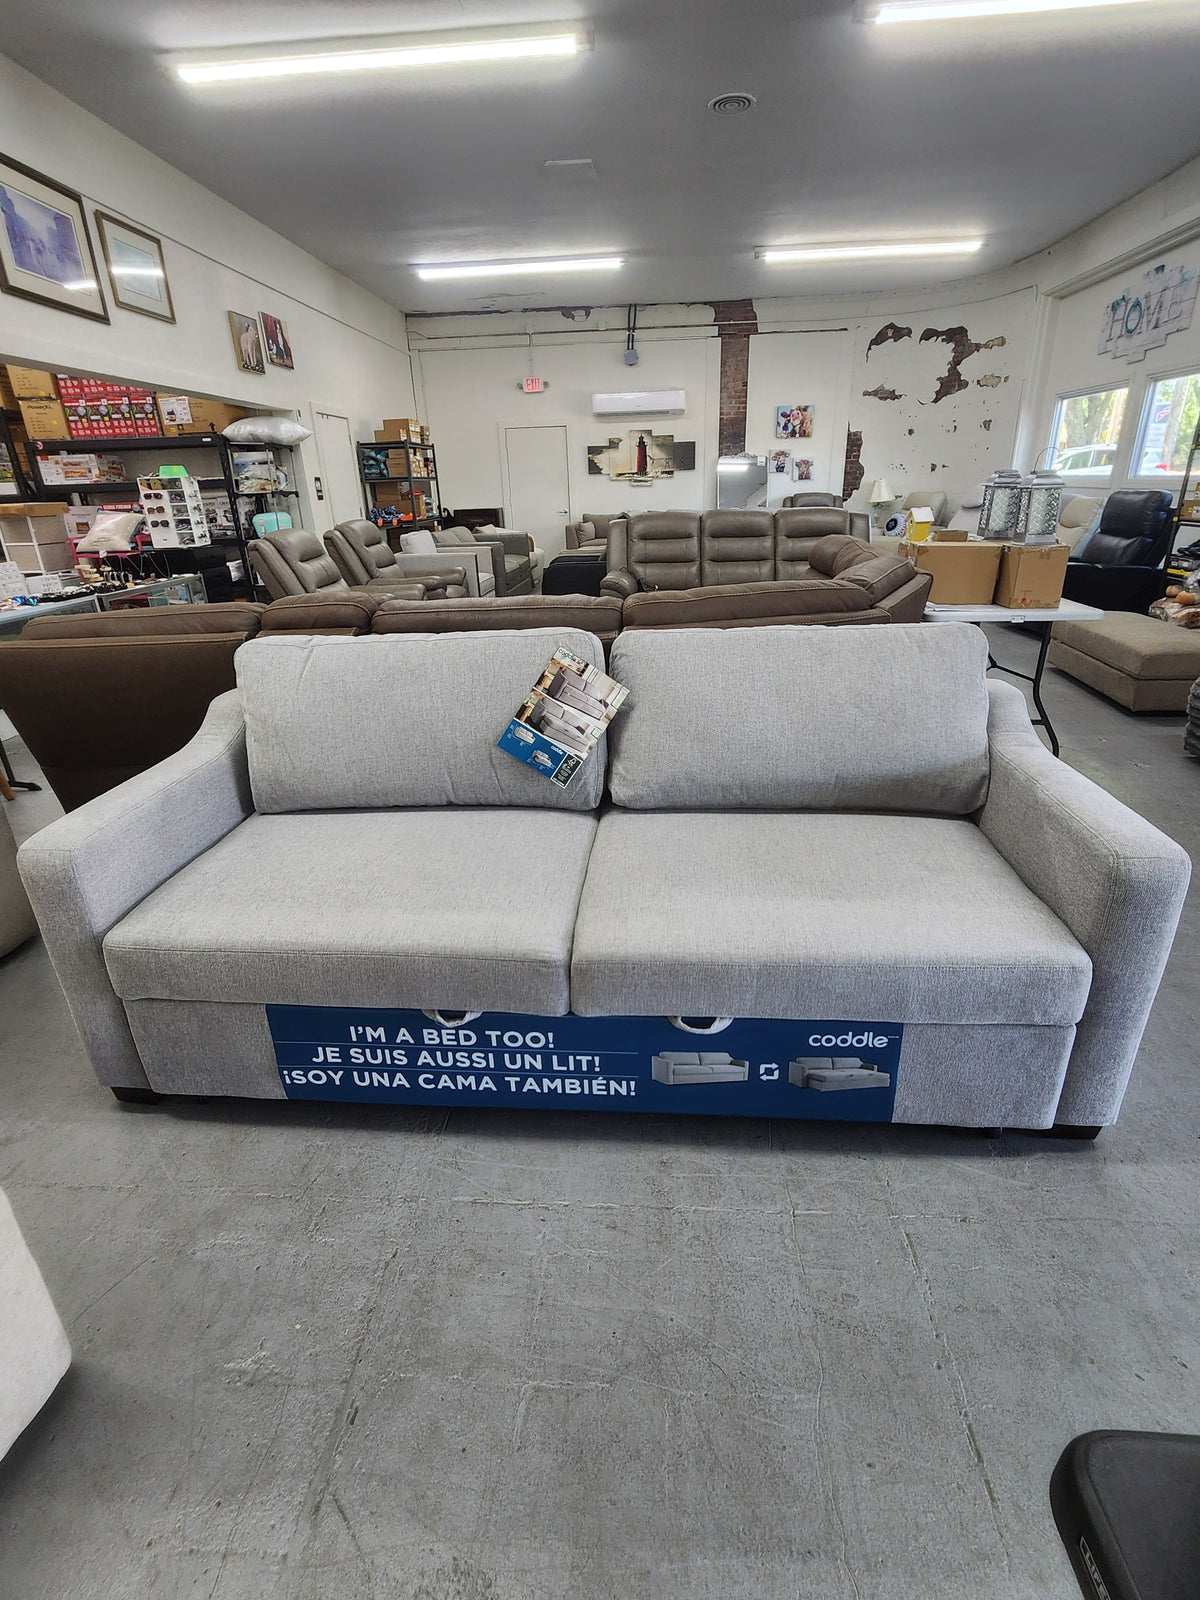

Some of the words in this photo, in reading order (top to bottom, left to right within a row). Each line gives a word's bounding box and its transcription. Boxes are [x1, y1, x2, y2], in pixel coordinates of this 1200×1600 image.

[1106, 286, 1188, 342] HOME
[526, 378, 540, 391] EXIT
[350, 1026, 386, 1043] I'M
[395, 1027, 415, 1044] A
[422, 1028, 477, 1046] BED
[485, 1030, 554, 1048] TOO!
[808, 1031, 889, 1048] coddle
[312, 1047, 342, 1063] JE
[350, 1048, 408, 1065] SUIS
[416, 1050, 495, 1069] AUSSI
[504, 1053, 543, 1070] UN
[552, 1055, 600, 1072] LIT!
[283, 1070, 344, 1085] ¡SOY
[353, 1071, 411, 1088] UNA
[418, 1073, 497, 1092] CAMA
[505, 1077, 636, 1096] TAMBIÉN!
